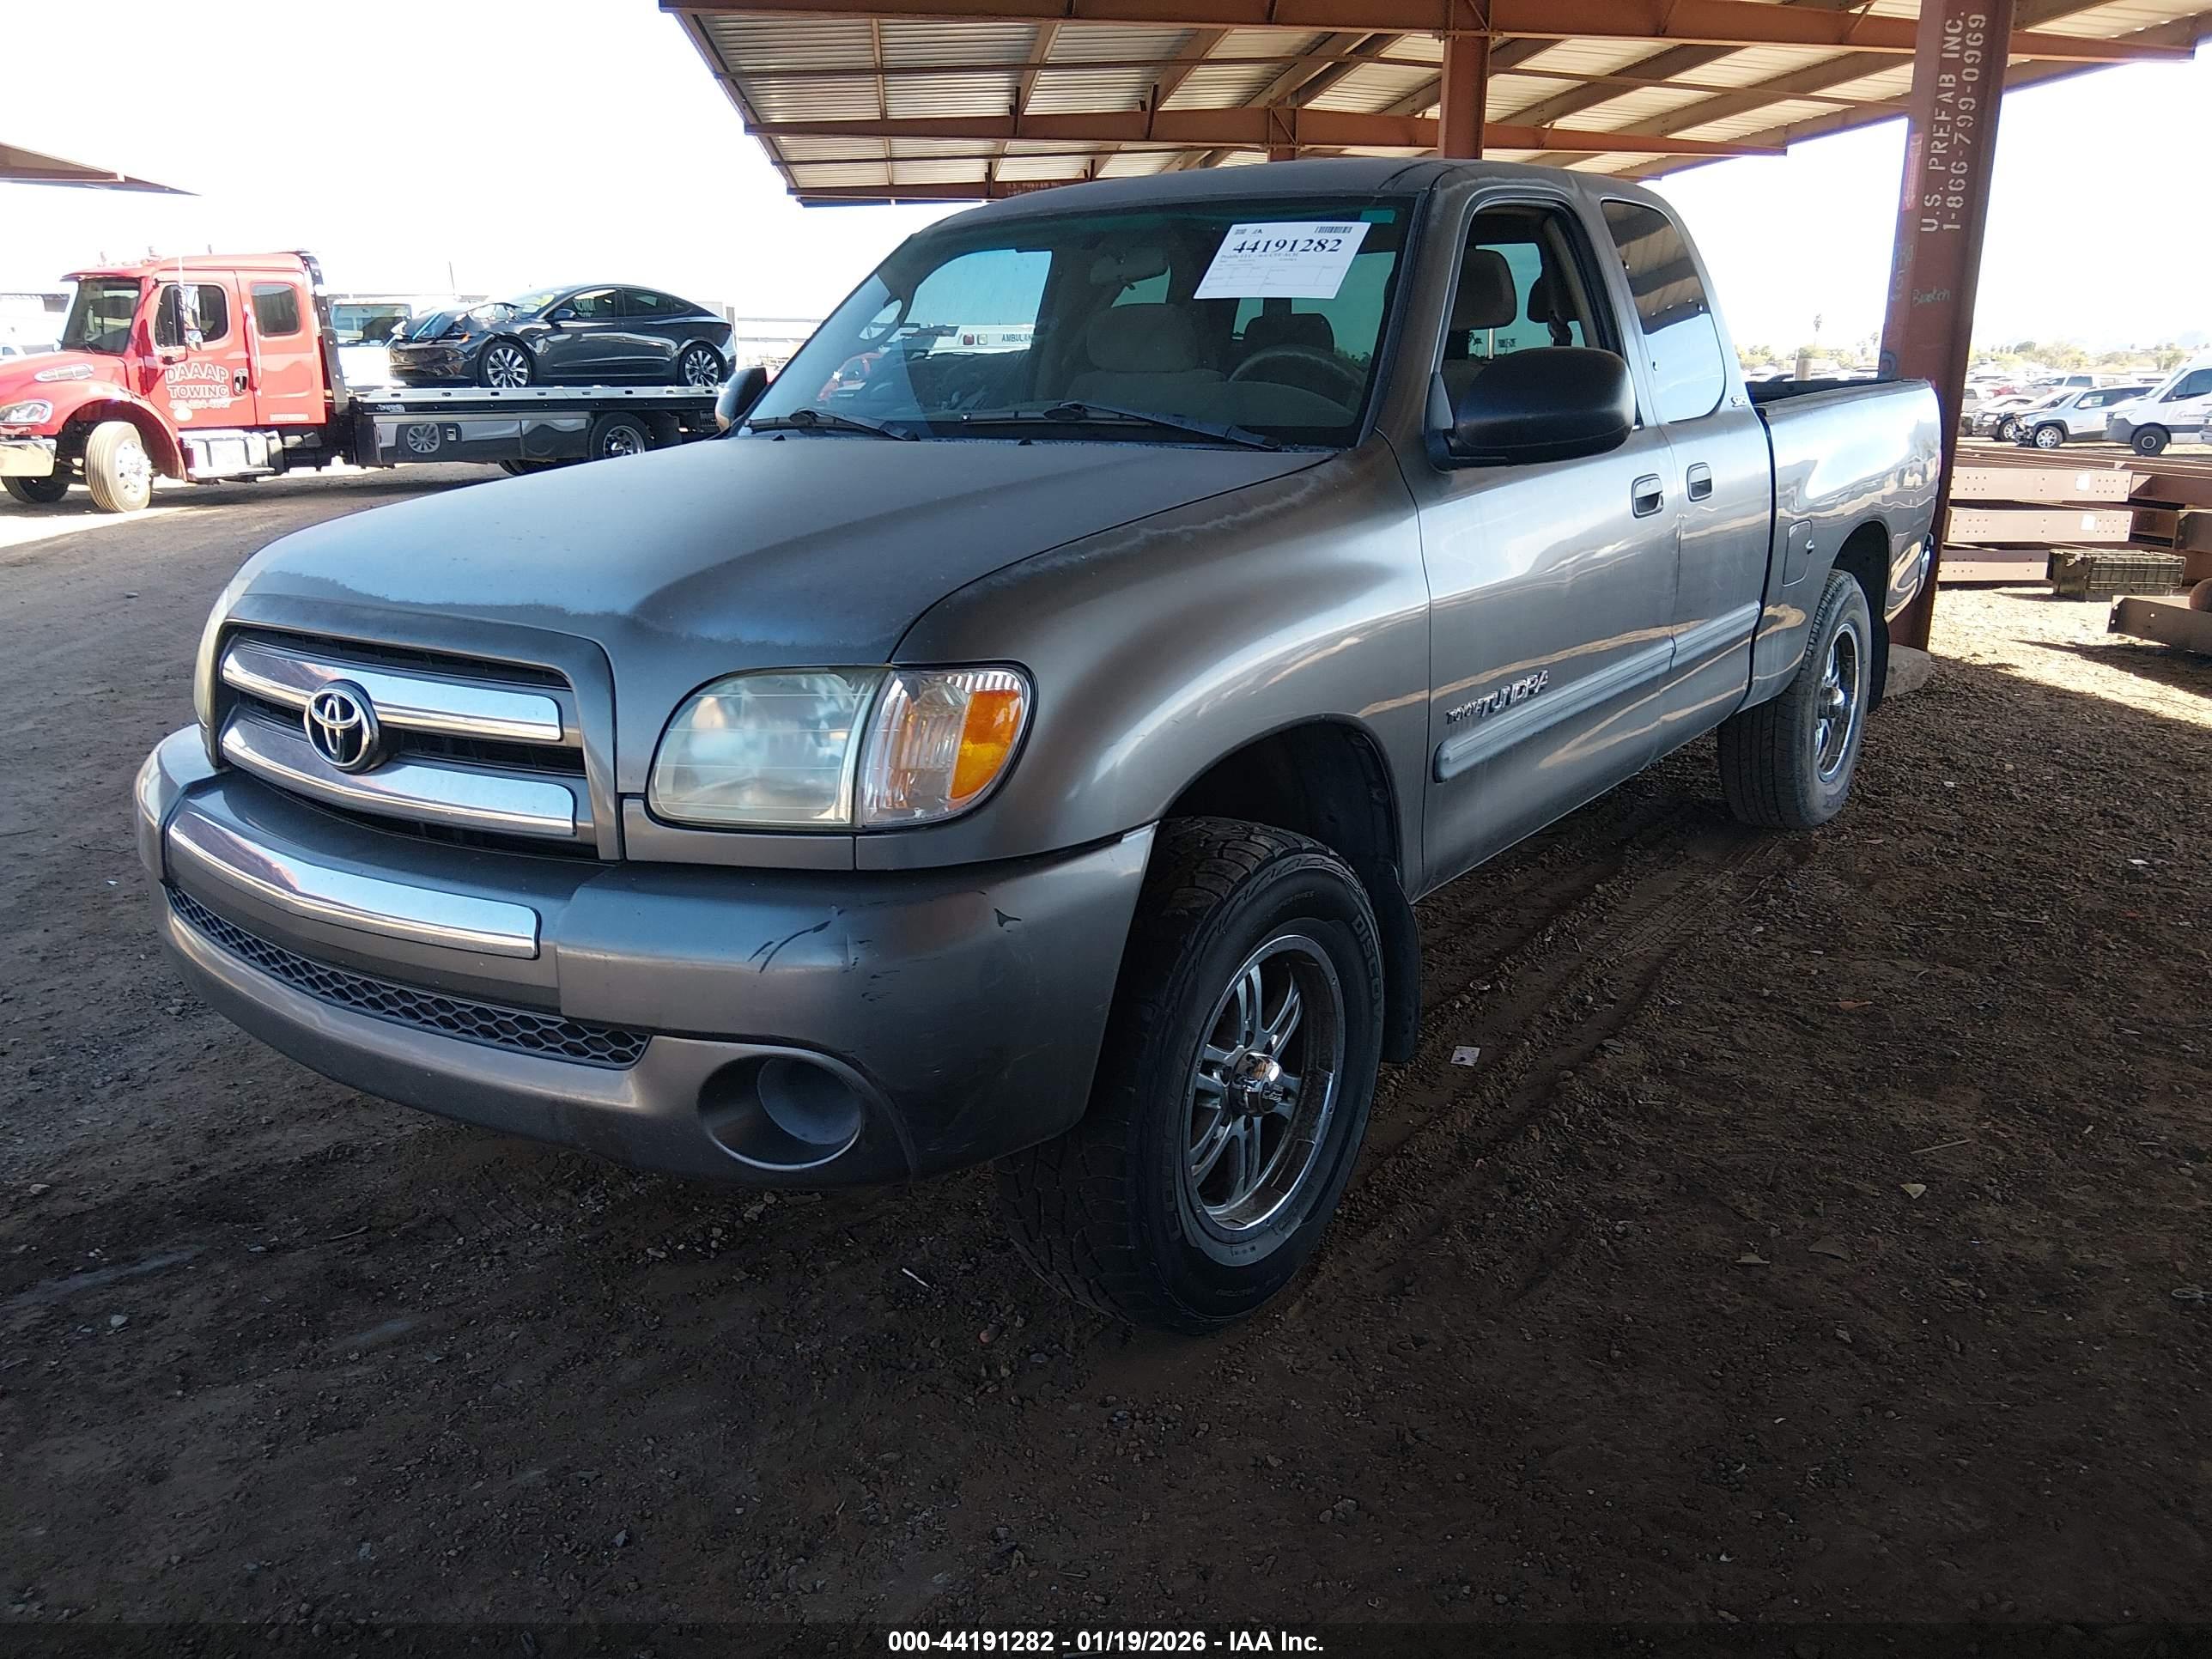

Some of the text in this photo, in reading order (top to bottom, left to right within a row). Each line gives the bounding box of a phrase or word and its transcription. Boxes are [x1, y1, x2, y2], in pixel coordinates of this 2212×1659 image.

[1920, 10, 1966, 233] U.S. PREFAB INC.
[1942, 13, 1987, 232] 1-866-799-0969
[1233, 239, 1344, 253] 44191282
[165, 362, 229, 385] DAAAP
[167, 385, 230, 398] TOWING
[1480, 669, 1549, 718] TUNDRA
